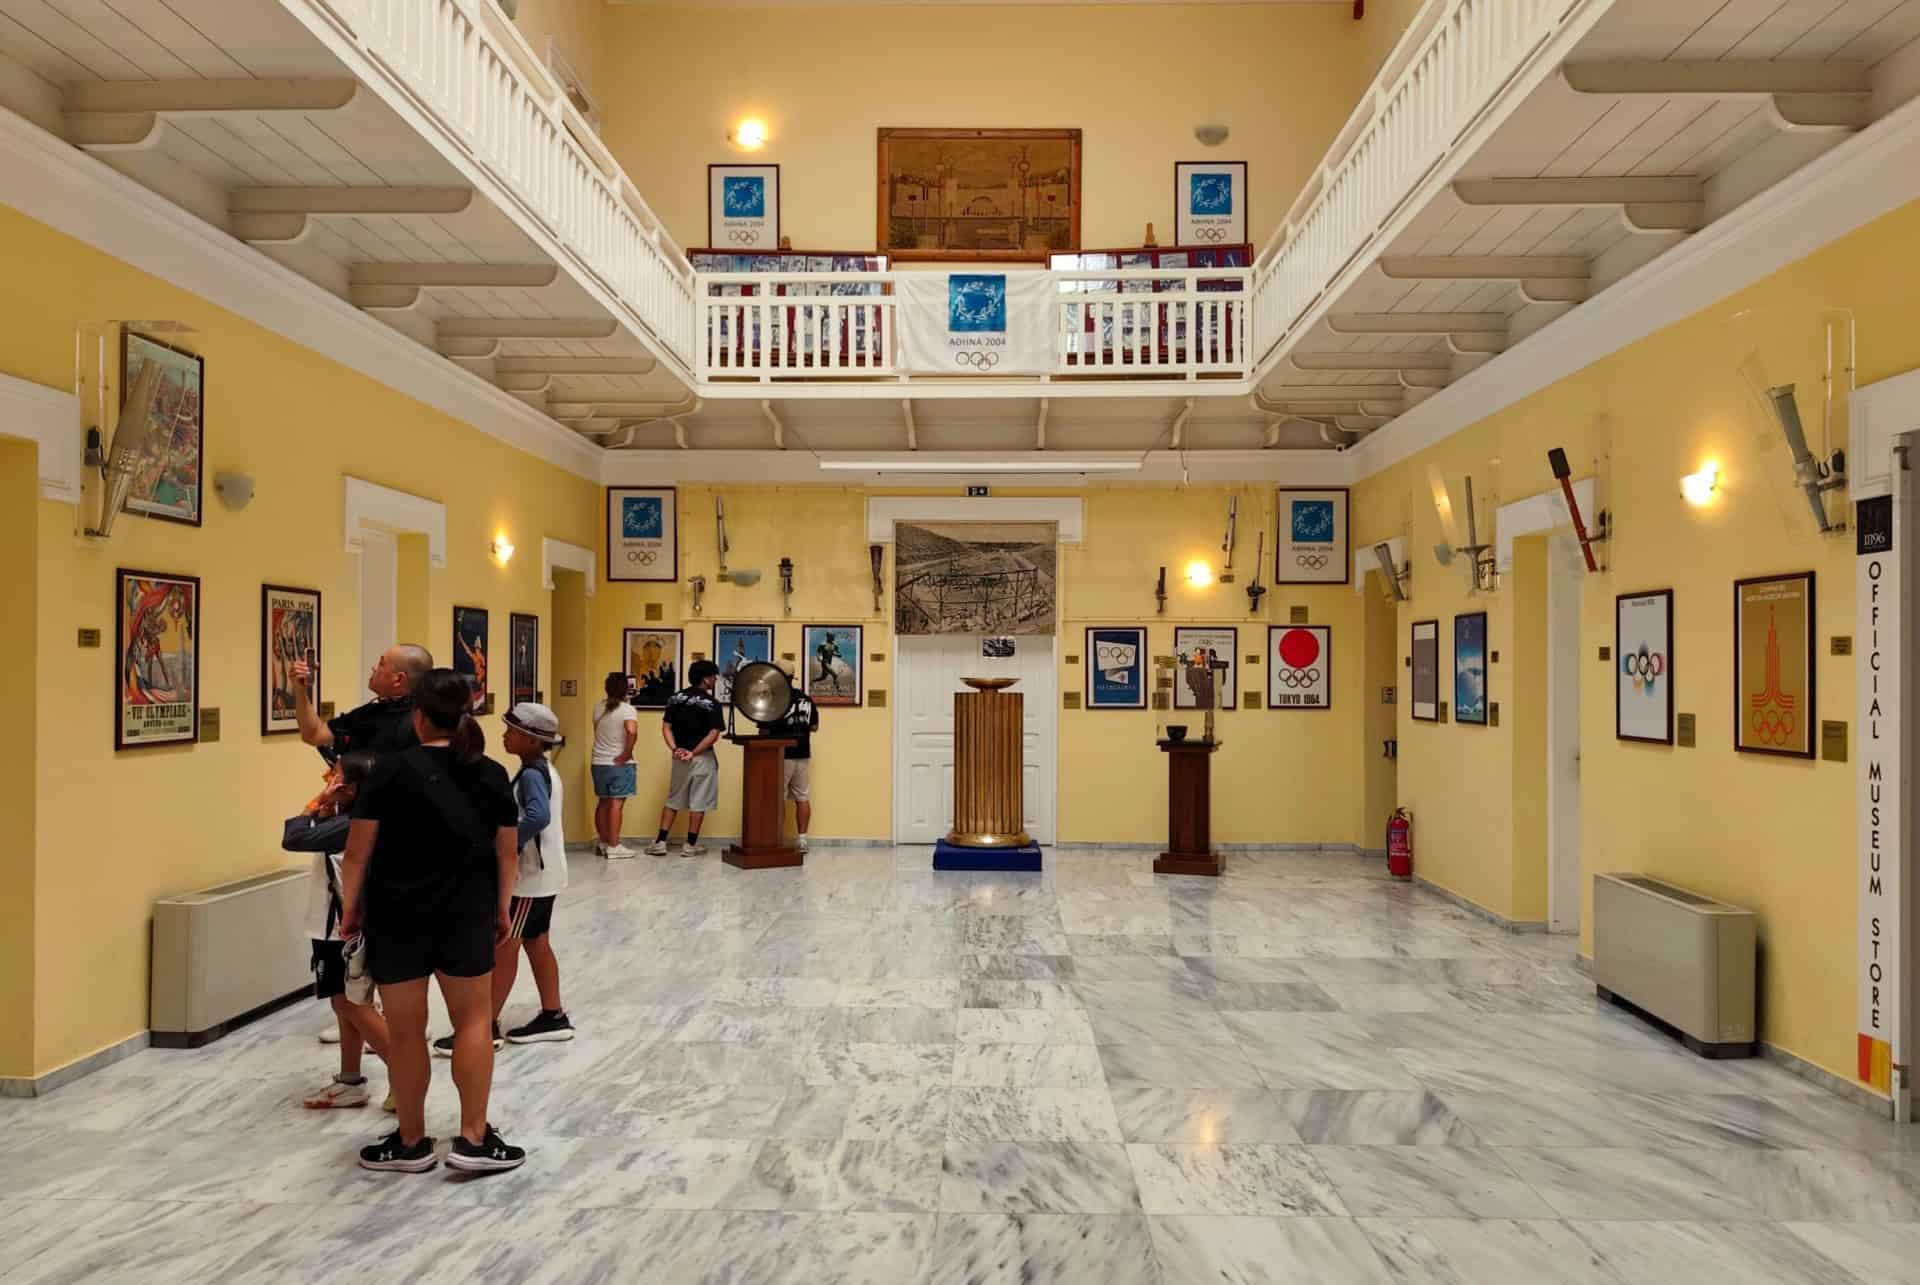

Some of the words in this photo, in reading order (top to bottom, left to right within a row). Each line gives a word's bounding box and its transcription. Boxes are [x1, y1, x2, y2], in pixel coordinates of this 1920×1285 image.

[985, 337, 1006, 346] 2004
[271, 598, 296, 609] PARIS
[1868, 561, 1882, 739] OFFICIAL
[1278, 693, 1301, 705] TOKYO
[1303, 693, 1321, 705] 1964
[1868, 760, 1882, 897] MUSEUM
[1869, 917, 1882, 1030] STORE
